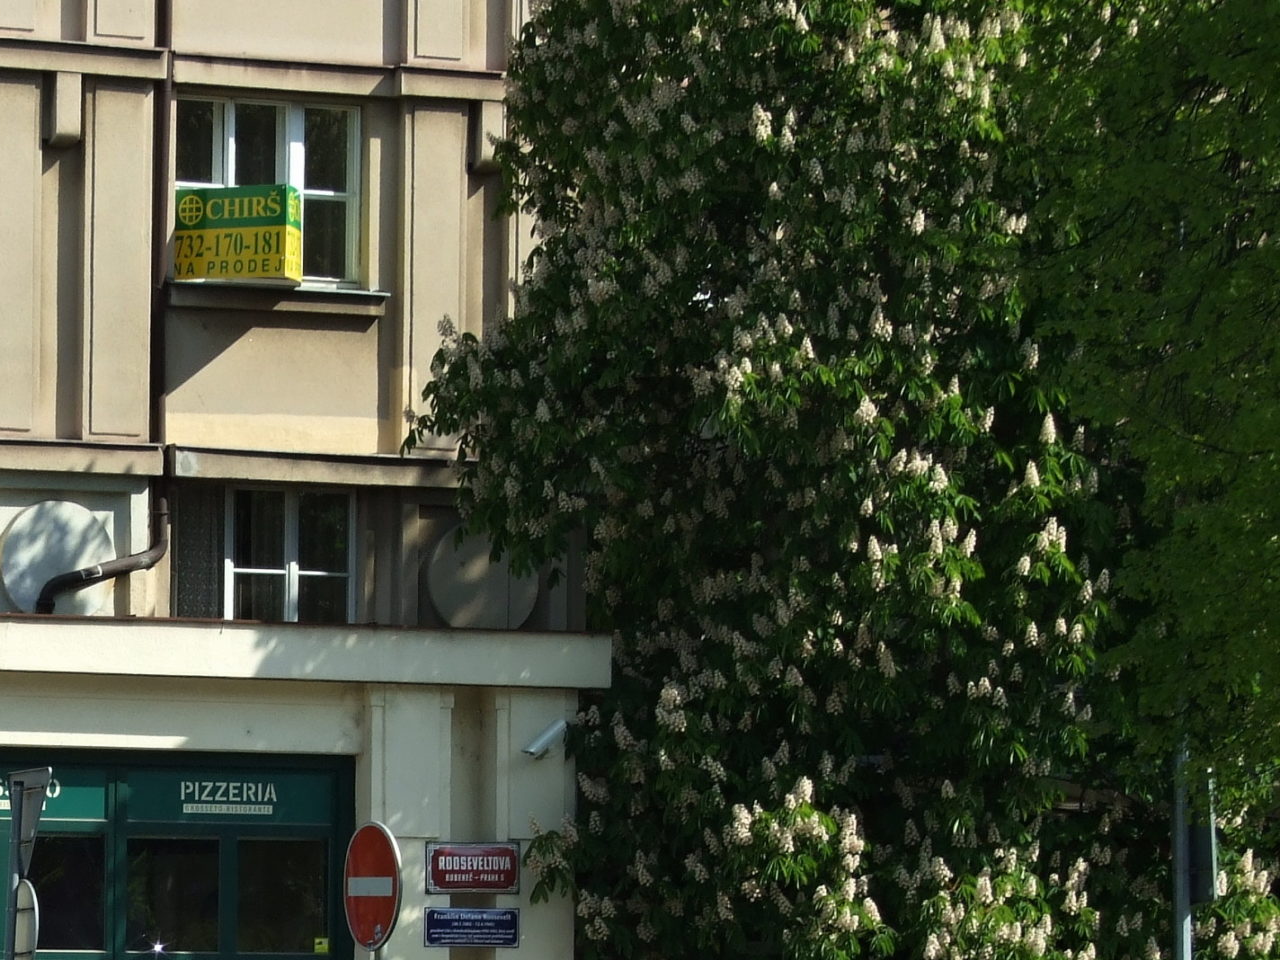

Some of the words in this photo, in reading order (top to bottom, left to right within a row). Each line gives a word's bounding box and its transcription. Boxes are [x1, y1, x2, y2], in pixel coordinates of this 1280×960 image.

[206, 191, 281, 219] CHIRŠ
[175, 230, 281, 259] 732-170-181
[174, 263, 195, 276] NA
[207, 258, 282, 275] PRODEJ
[181, 781, 277, 802] PIZZERIA
[438, 855, 511, 870] ROOSEVELTOVA
